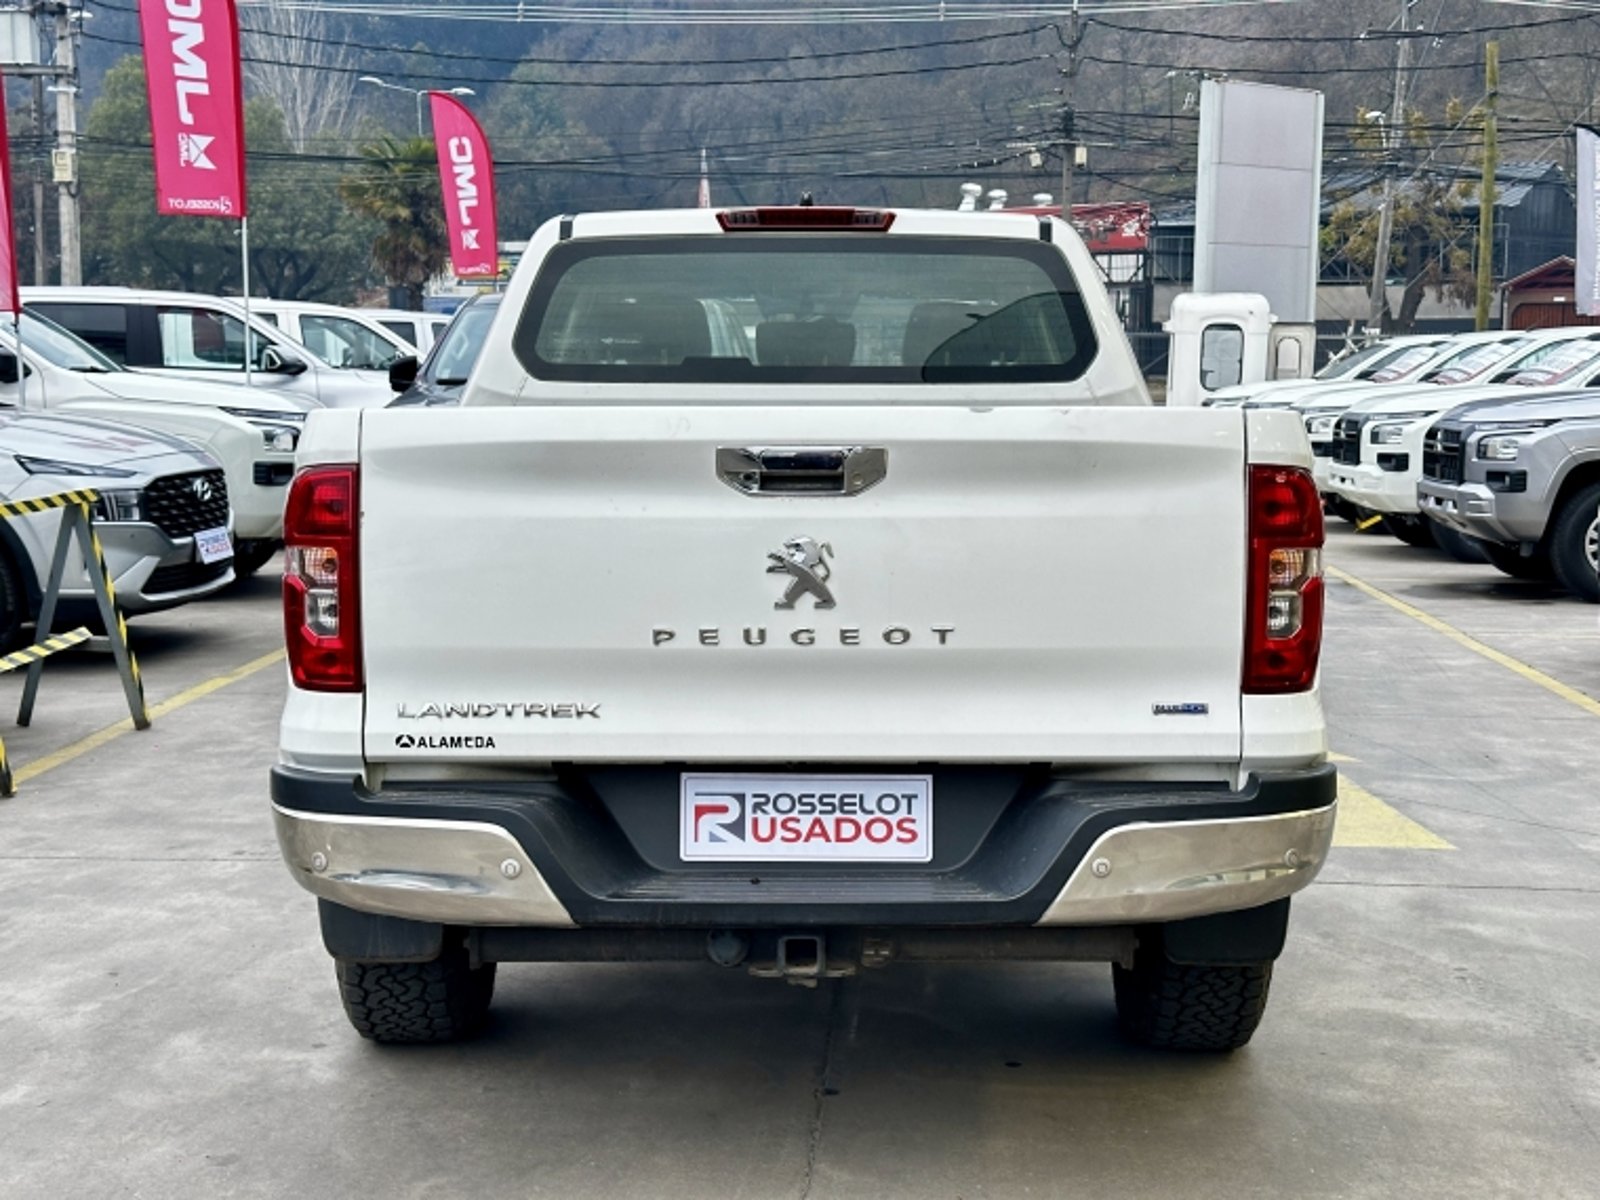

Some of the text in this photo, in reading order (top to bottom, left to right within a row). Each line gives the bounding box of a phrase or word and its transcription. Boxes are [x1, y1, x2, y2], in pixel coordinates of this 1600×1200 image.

[652, 625, 956, 647] PEUGEOT
[396, 702, 602, 720] LANDTREK
[751, 793, 919, 815] ROSSELOT
[751, 816, 919, 844] USADOS
